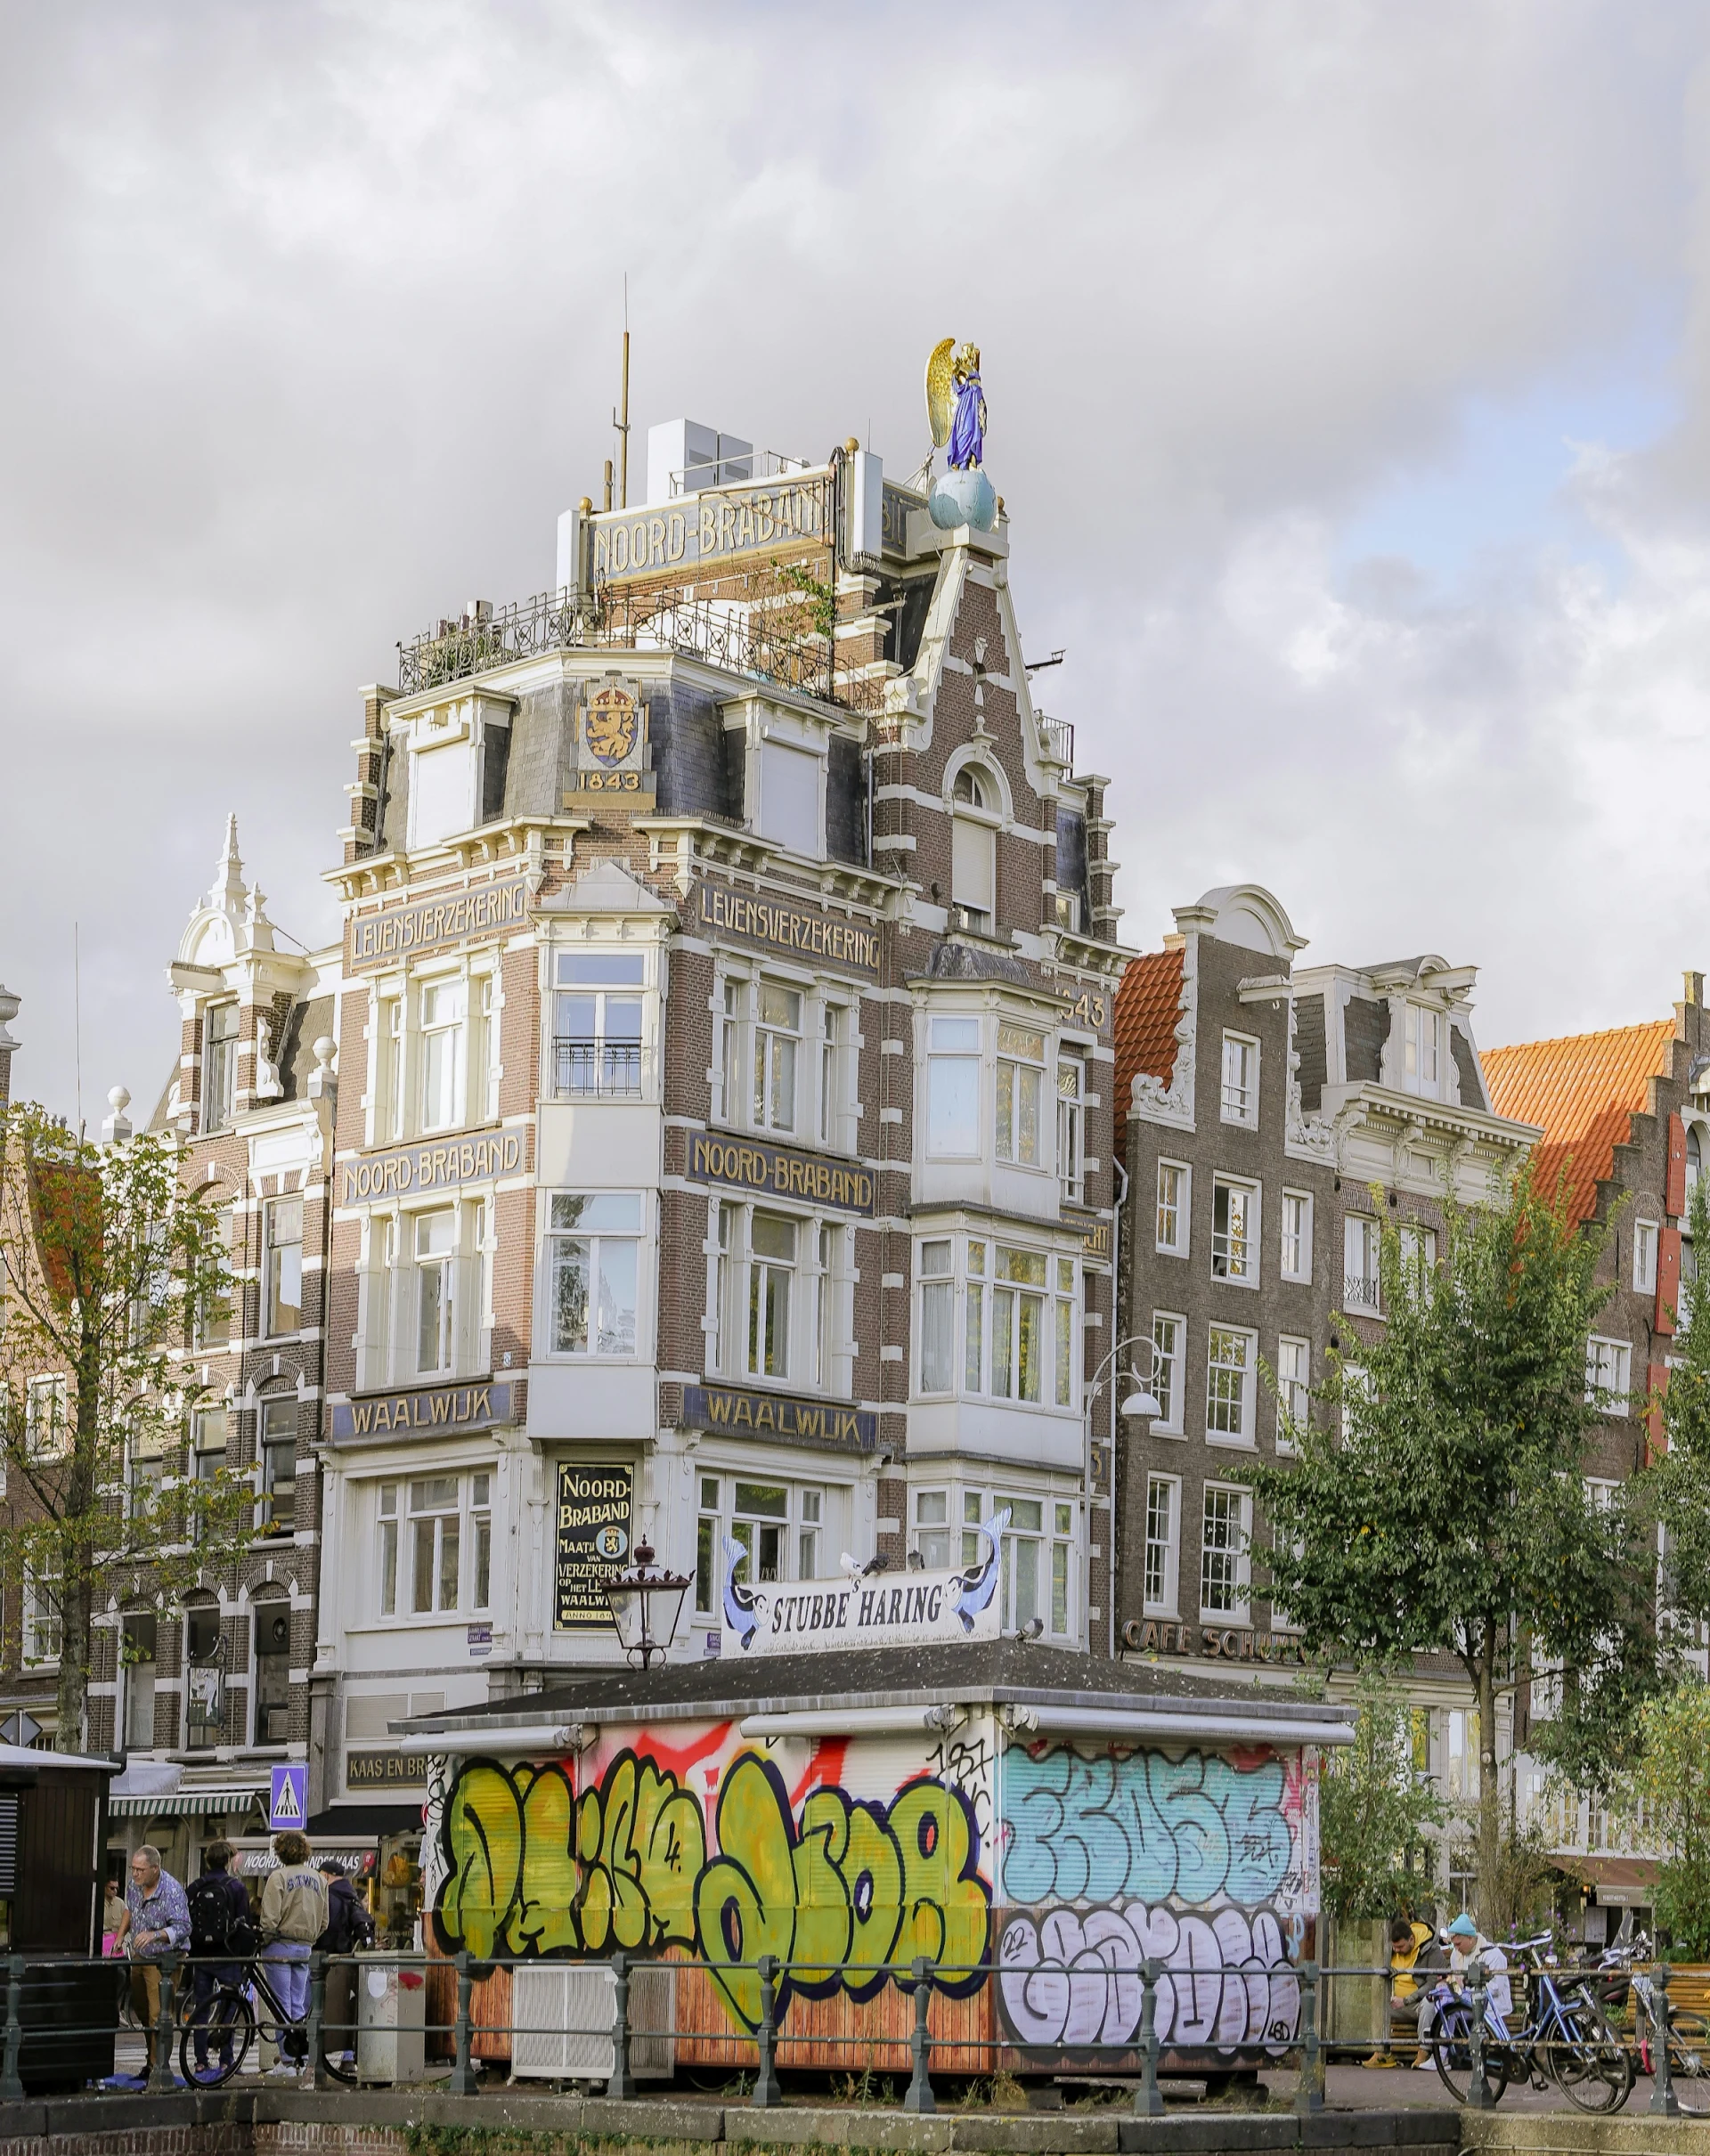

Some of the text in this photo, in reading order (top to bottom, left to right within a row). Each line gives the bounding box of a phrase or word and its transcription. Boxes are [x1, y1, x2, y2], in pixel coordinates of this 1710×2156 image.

[580, 771, 639, 791] 1843
[353, 883, 525, 960] LEVENSVERZEKERING
[701, 887, 880, 968] LEVENSVERZEKERING
[344, 1135, 519, 1200] NOORD-BRABAND
[695, 1137, 872, 1208] NOORD-BRABAND
[352, 1387, 492, 1435] WAALWIJK
[706, 1391, 860, 1443] WAALWIJK
[563, 1474, 631, 1498] NOORD-
[559, 1501, 630, 1529] BRABAND
[587, 1555, 601, 1563] VAN
[558, 1578, 572, 1587] OP
[570, 1583, 587, 1593] HET
[858, 1585, 942, 1626] HARING
[1121, 1619, 1192, 1653] CAFE
[350, 1757, 428, 1778] KAAS EN BR
